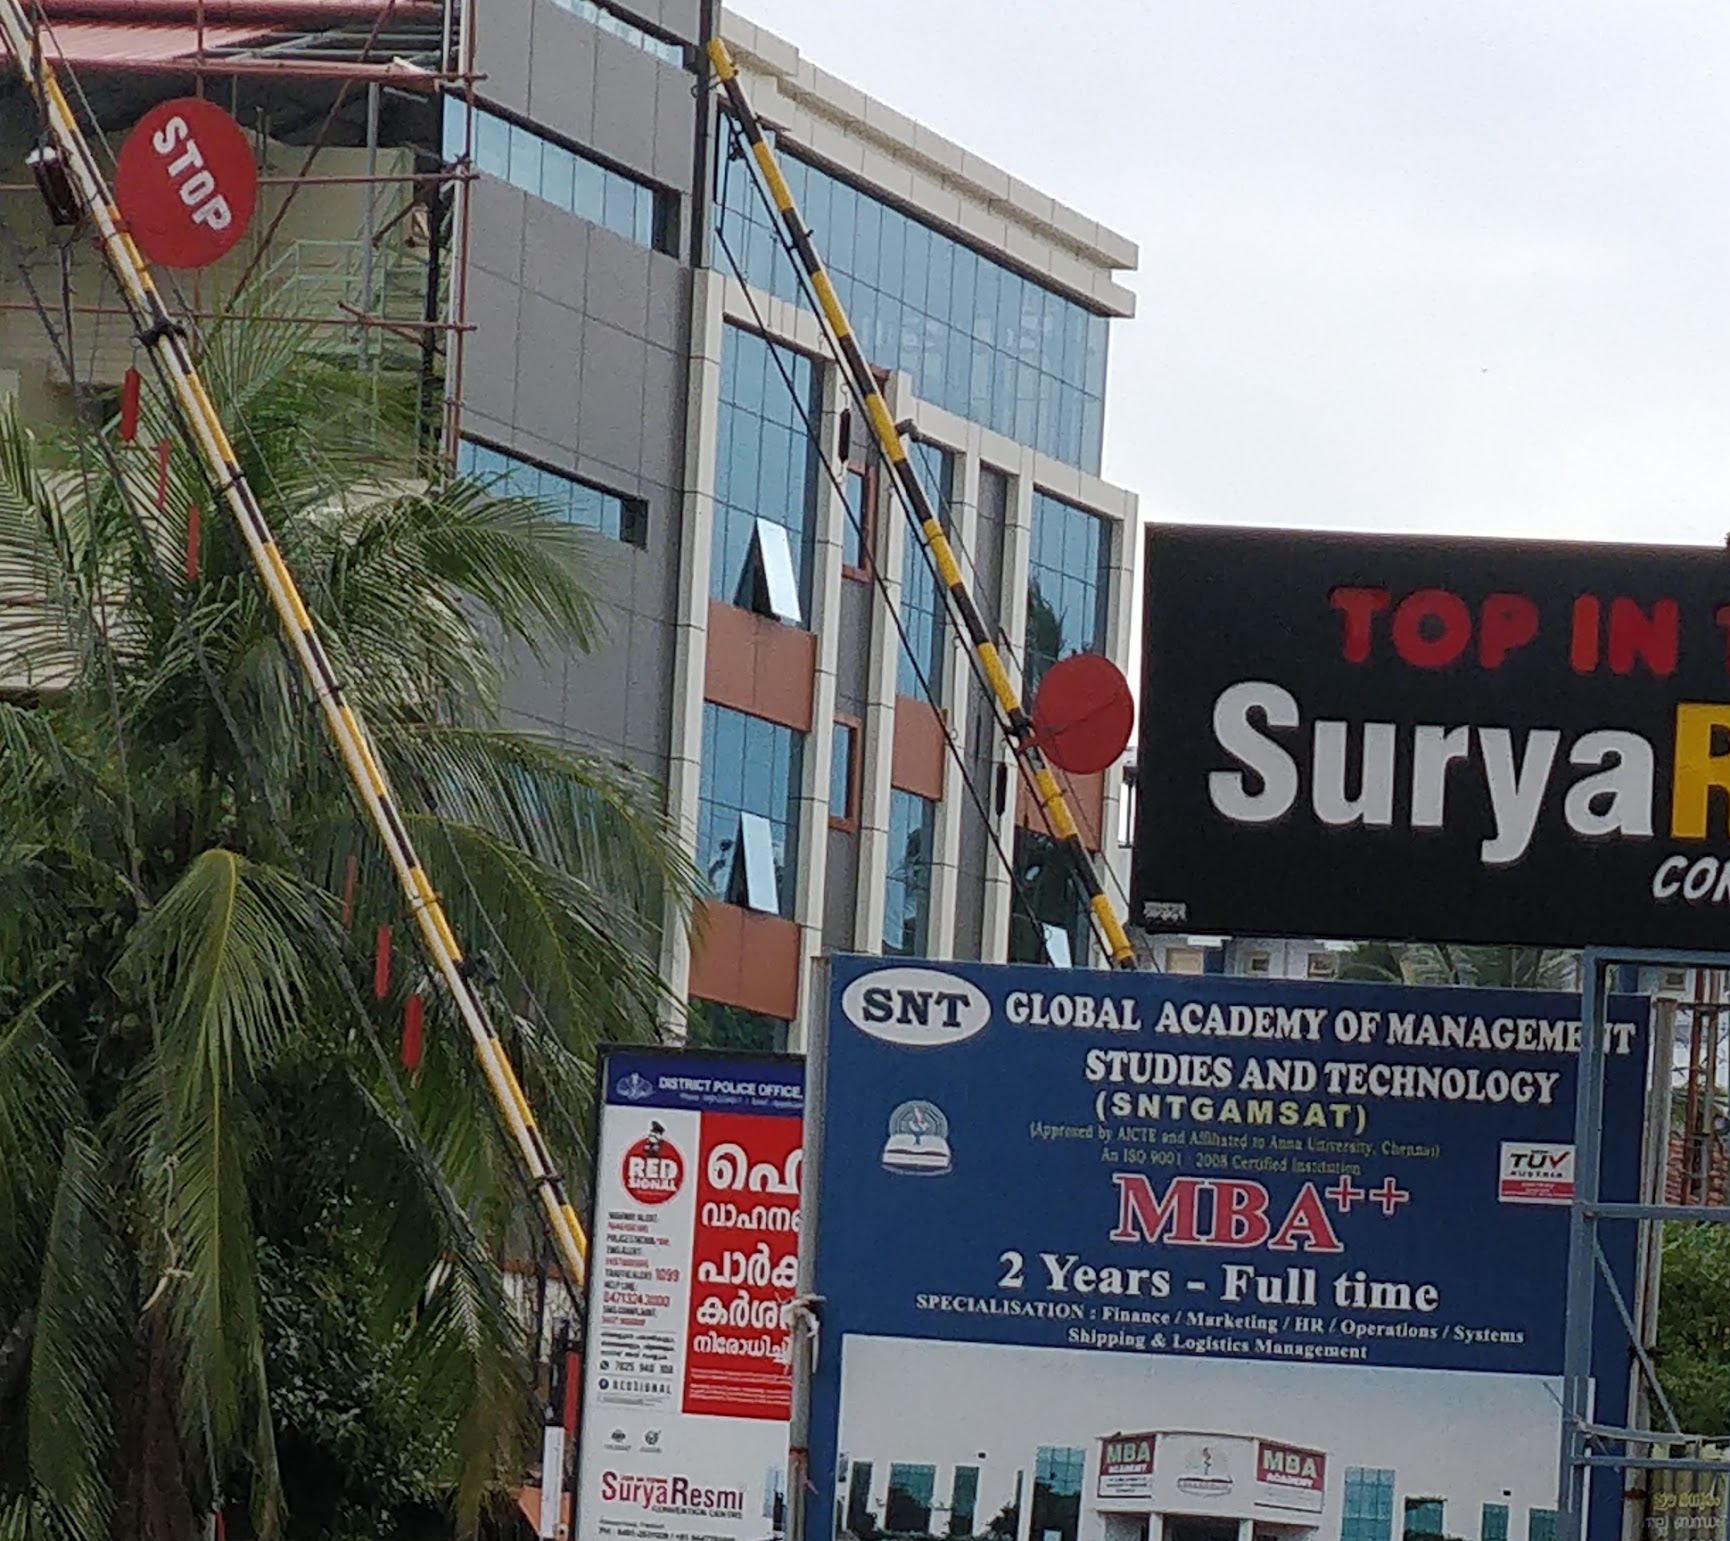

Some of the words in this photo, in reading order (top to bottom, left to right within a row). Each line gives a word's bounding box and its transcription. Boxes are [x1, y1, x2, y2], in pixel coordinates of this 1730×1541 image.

[152, 116, 232, 231] STOP
[1328, 586, 1541, 672] TOP
[1570, 595, 1680, 679] IN
[861, 987, 972, 1028] SNT
[1005, 991, 1142, 1032] GLOBAL
[1155, 1002, 1327, 1041] ACADEMY
[1334, 1008, 1382, 1044] OF
[1386, 1013, 1638, 1056] MANAGEMET
[658, 1077, 711, 1092] DISTRICT
[713, 1080, 755, 1096] POLICE
[1085, 1049, 1233, 1089] STUDIES
[1239, 1057, 1317, 1093] AND
[1324, 1061, 1561, 1104] TECHNOLOGY
[1095, 1090, 1368, 1135] (SNTGAMSAT)
[1122, 1148, 1147, 1164] ISO
[1162, 1129, 1185, 1145] and
[628, 1157, 679, 1179] RED
[998, 1251, 1025, 1289] 2
[1039, 1253, 1171, 1298] Years
[1220, 1264, 1318, 1308] Full
[1333, 1271, 1440, 1312] time
[916, 1294, 1085, 1320] SPECIALISATION
[1102, 1306, 1170, 1326] Finance
[1187, 1311, 1279, 1334] Marketing
[1295, 1316, 1325, 1334] HR
[1340, 1319, 1438, 1339] Operations
[1453, 1324, 1525, 1345] Systems
[1068, 1327, 1146, 1349] Shipping
[1150, 1333, 1167, 1349] &
[1173, 1336, 1250, 1353] Logistics
[1254, 1338, 1368, 1360] Management
[1106, 1441, 1151, 1464] MBA
[1262, 1450, 1318, 1479] MBA
[602, 1470, 745, 1510] SuryaResmi
